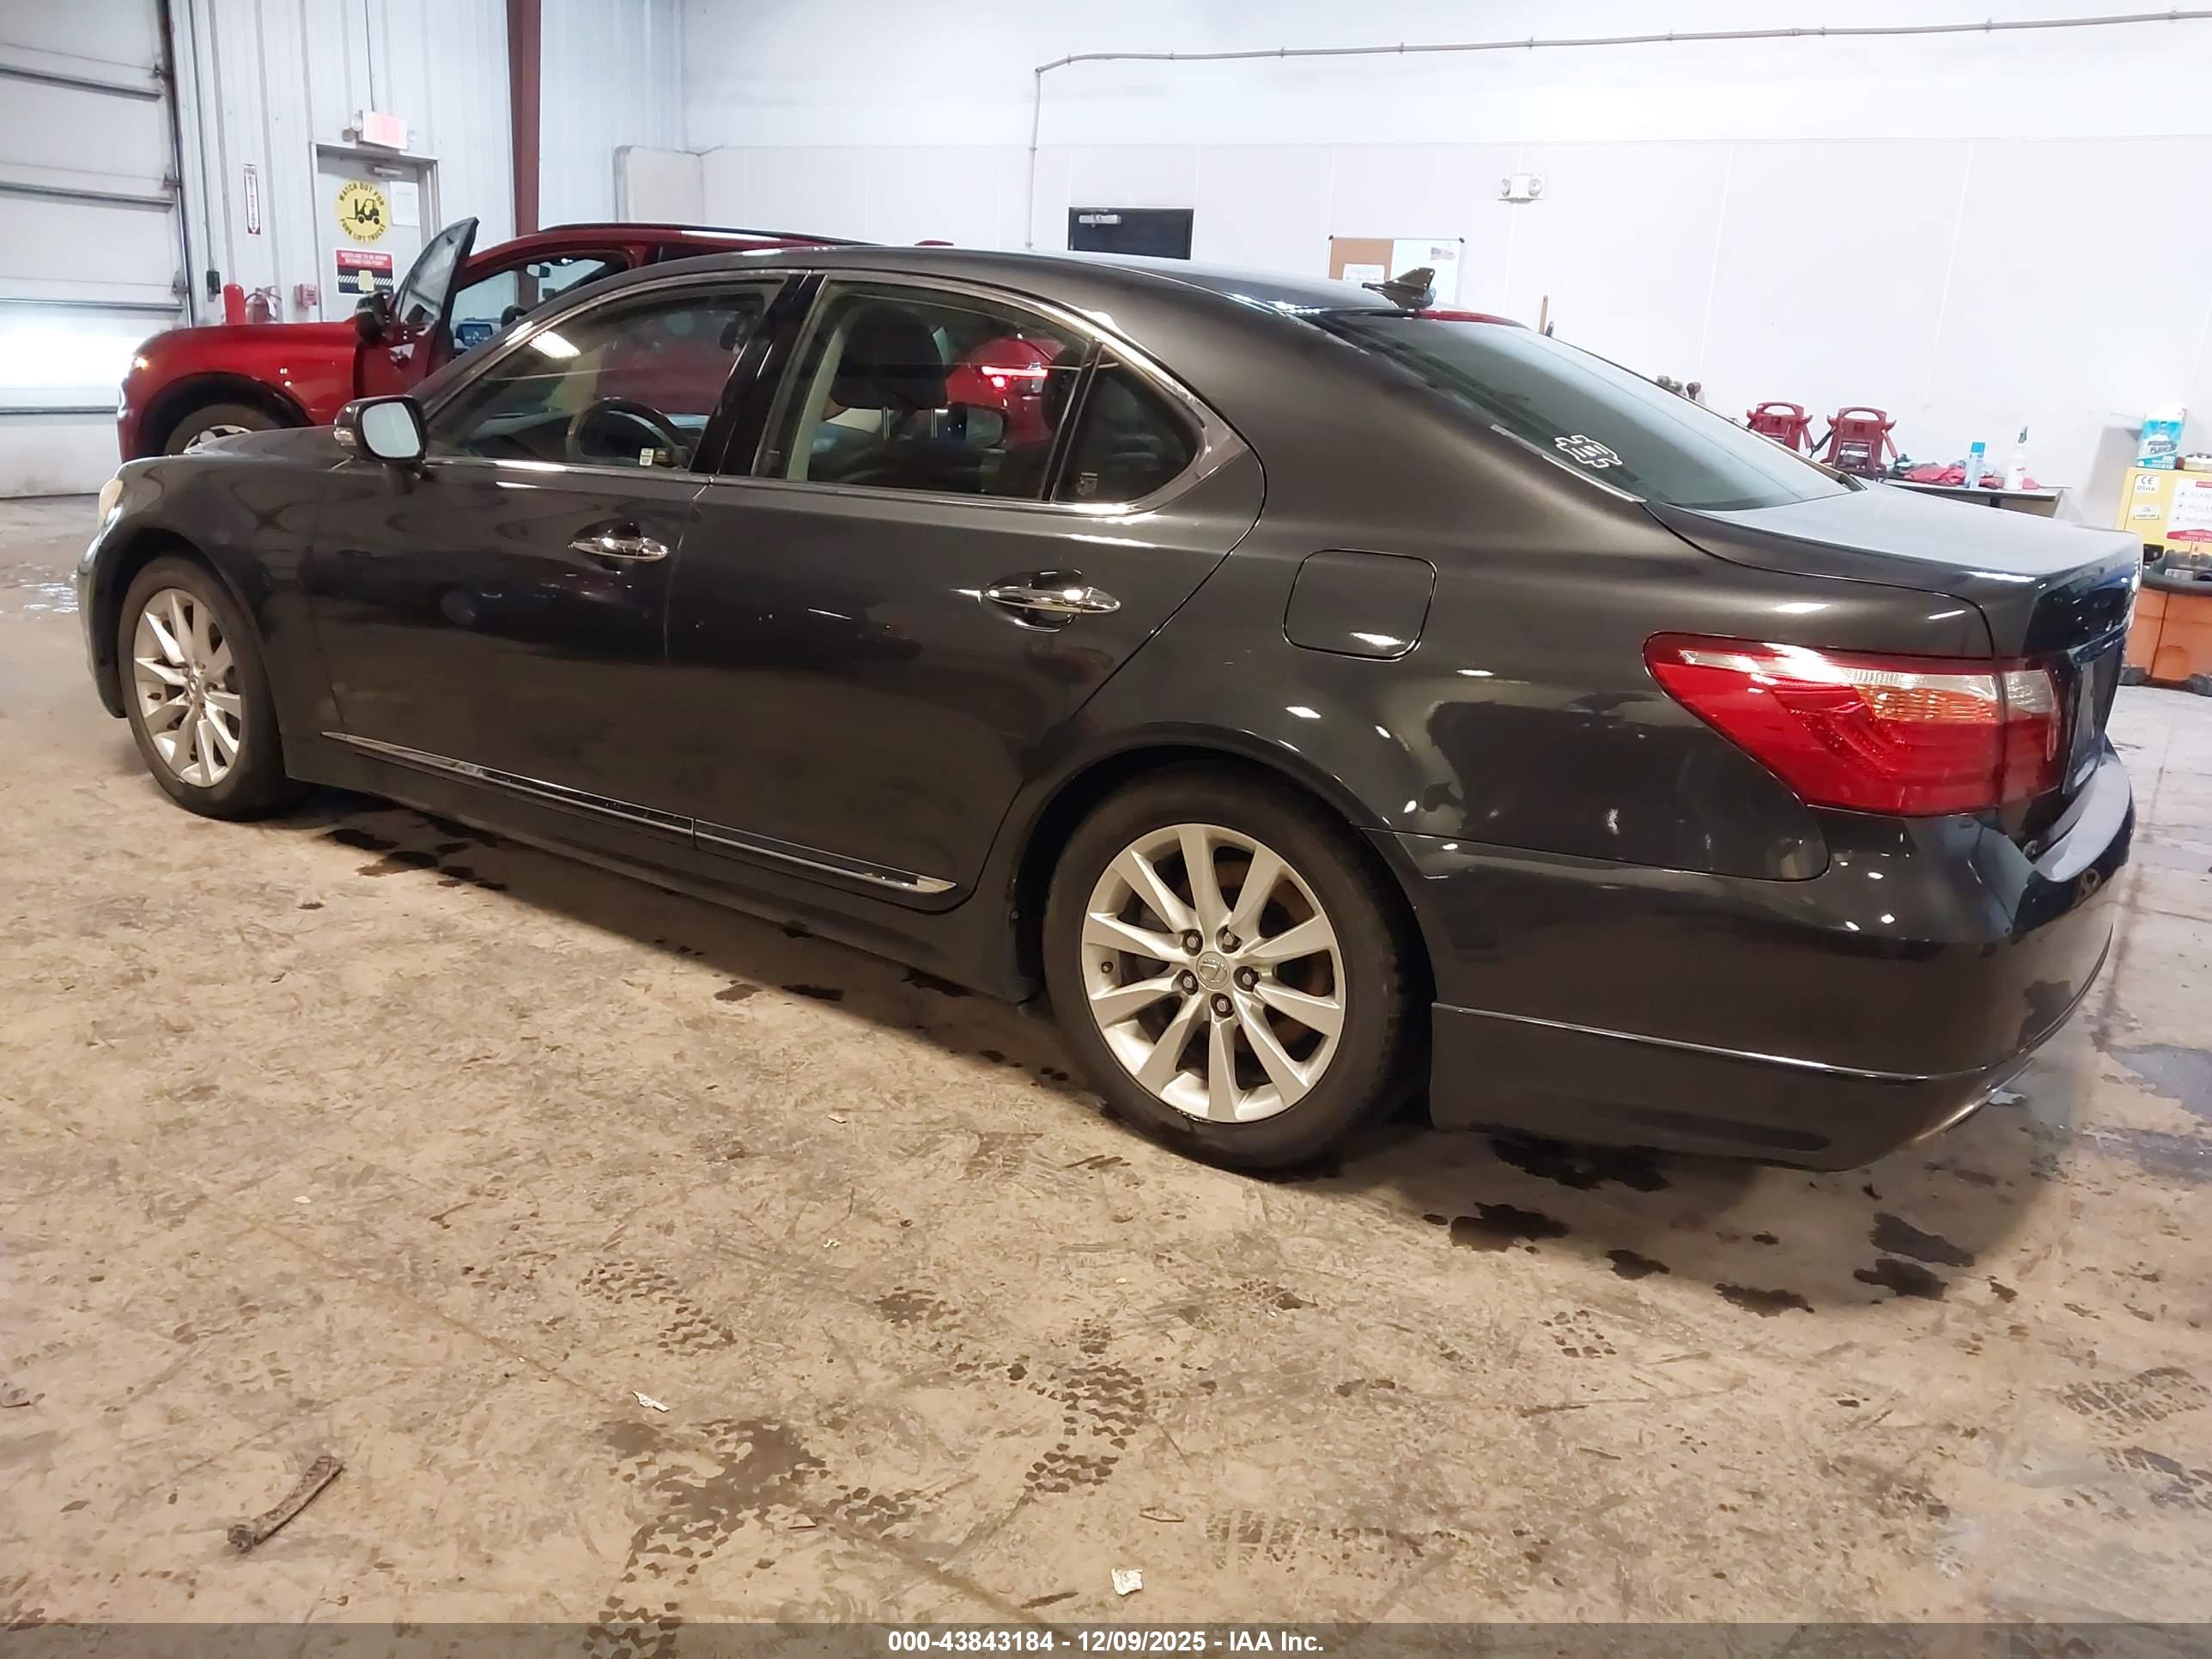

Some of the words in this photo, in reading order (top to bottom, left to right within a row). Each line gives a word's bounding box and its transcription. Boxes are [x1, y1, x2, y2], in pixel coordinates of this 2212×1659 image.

[338, 182, 358, 202] WATCH
[359, 181, 373, 192] OUT
[373, 191, 385, 206] FOR
[340, 218, 352, 235] FORK
[353, 233, 366, 241] LIFT
[367, 223, 386, 241] TRUCKS
